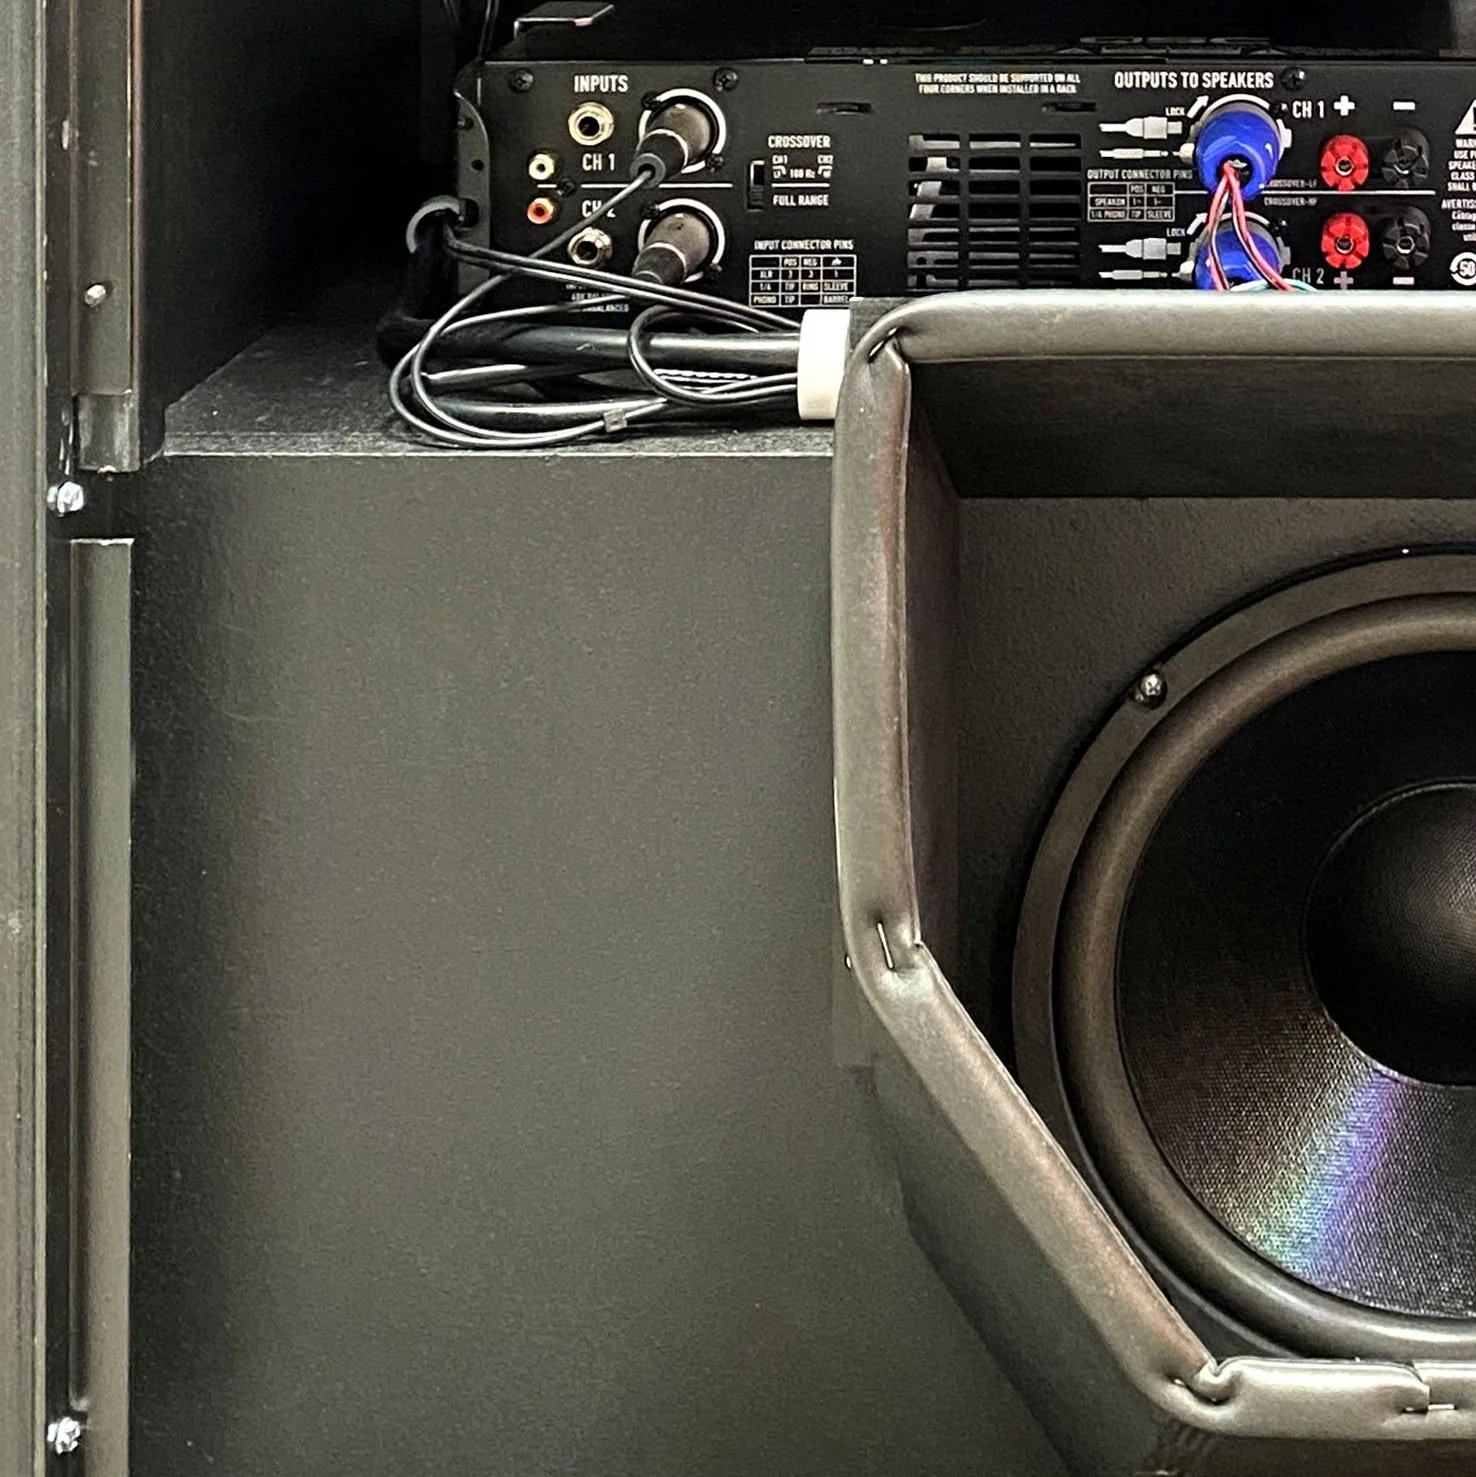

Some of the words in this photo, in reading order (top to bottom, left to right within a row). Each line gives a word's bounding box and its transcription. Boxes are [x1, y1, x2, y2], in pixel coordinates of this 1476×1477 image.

[573, 74, 629, 93] INPUTS
[933, 73, 967, 83] PRODUCT
[968, 73, 998, 83] SHOULD
[1010, 73, 1053, 83] SUPPORTED
[1066, 73, 1081, 83] ALL
[1114, 71, 1178, 89] OUTPUTS
[1180, 71, 1199, 89] TO
[1201, 71, 1274, 89] SPEAKERS
[918, 84, 939, 93] FOUR
[940, 84, 975, 93] CORNERS
[976, 84, 998, 93] WHEN
[999, 84, 1039, 93] INSTALLED
[1165, 107, 1185, 116] LOCK
[1292, 100, 1312, 119] CH
[1317, 100, 1325, 119] 1
[767, 135, 831, 149] CROSSOVER
[1453, 150, 1469, 160] USE
[582, 153, 603, 171] CH
[608, 153, 615, 171] 1
[1087, 169, 1119, 180] OUTPUT
[1121, 169, 1172, 180] CONNECTOR
[1173, 169, 1193, 180] PINS
[1450, 171, 1474, 181] CLASS
[1447, 182, 1469, 192] SHALL
[772, 194, 796, 206] FULL
[798, 194, 829, 206] RANGE
[1166, 228, 1186, 237] LOCK
[754, 239, 780, 251] INPUT
[781, 239, 832, 251] CONNECTOR
[833, 239, 854, 251] PINS
[1292, 267, 1311, 284] CH
[1316, 267, 1325, 284] 2
